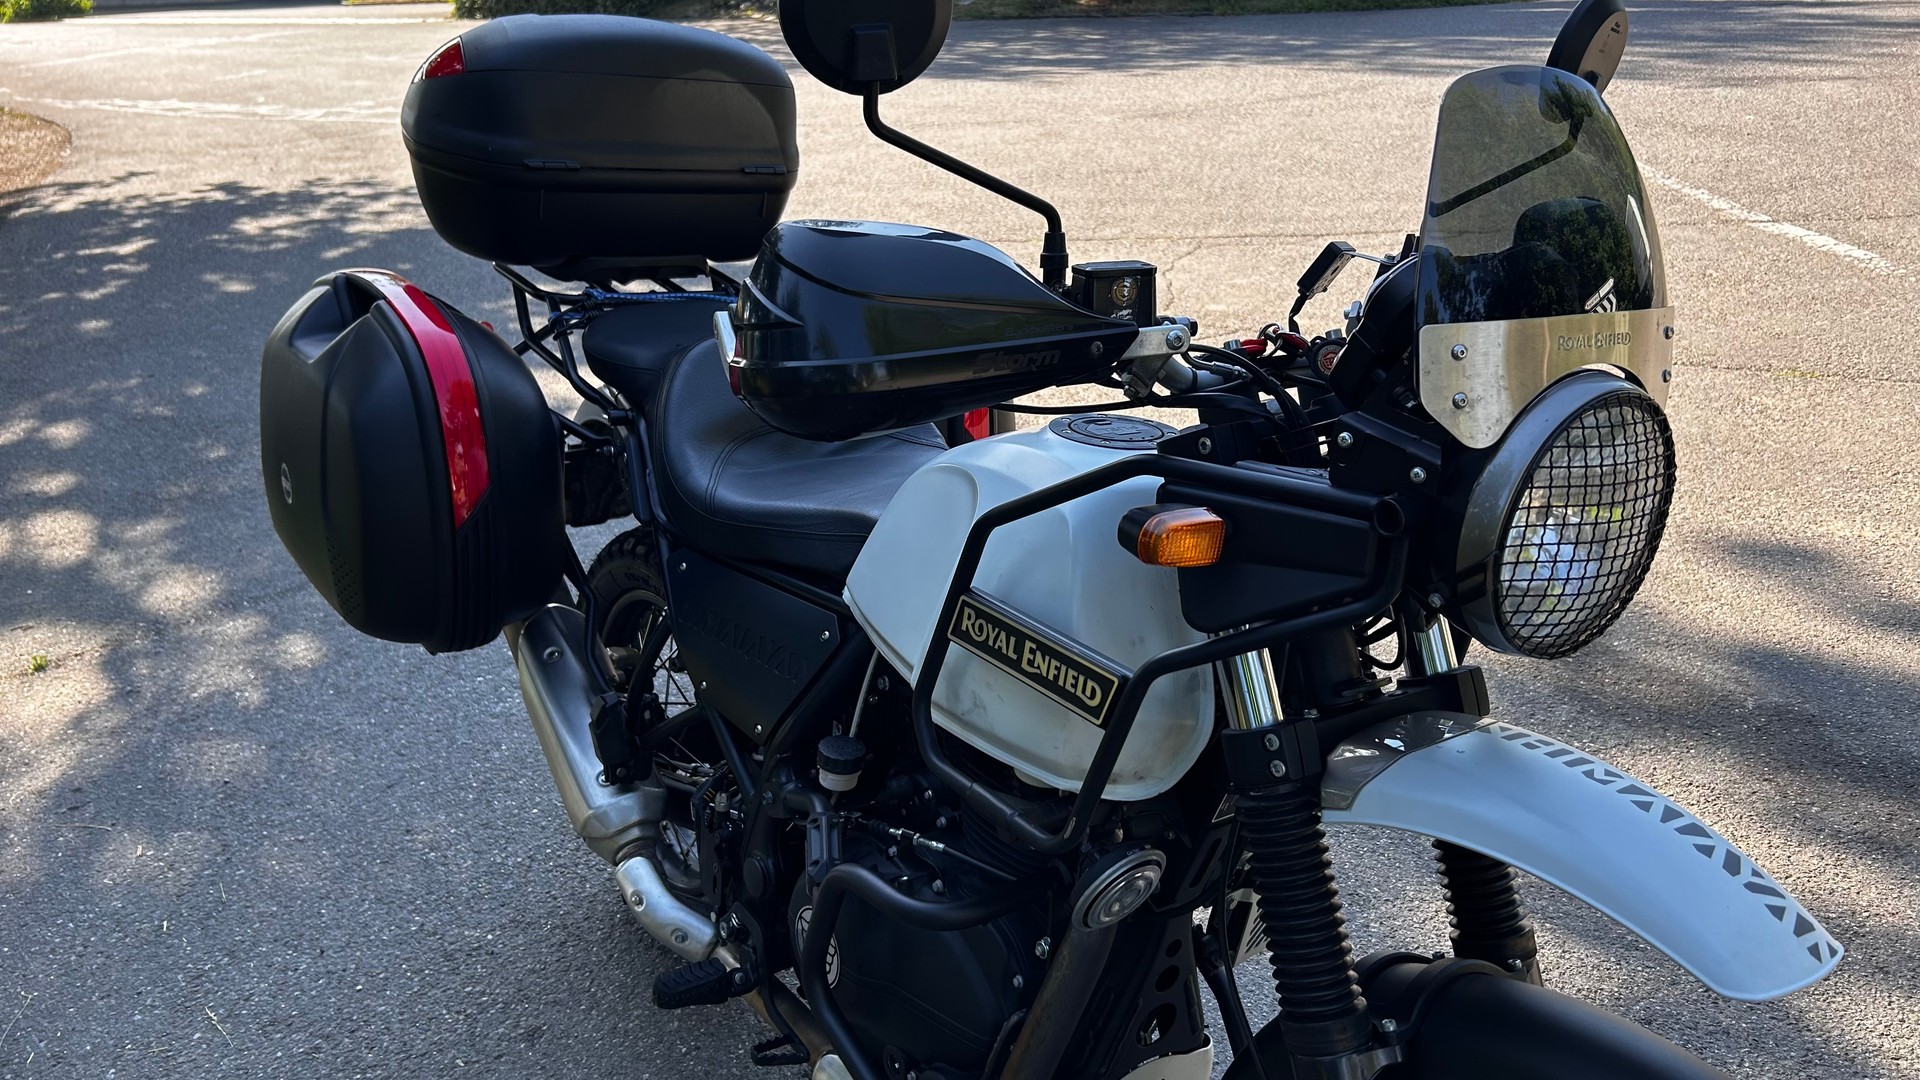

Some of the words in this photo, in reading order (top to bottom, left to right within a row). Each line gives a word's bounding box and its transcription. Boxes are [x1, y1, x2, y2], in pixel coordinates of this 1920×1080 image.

[1557, 334, 1592, 351] ROYAL
[1594, 331, 1632, 349] ENFIELD
[973, 349, 1061, 373] Storm
[961, 606, 1018, 660] ROYAL
[1021, 639, 1102, 707] ENFIELD
